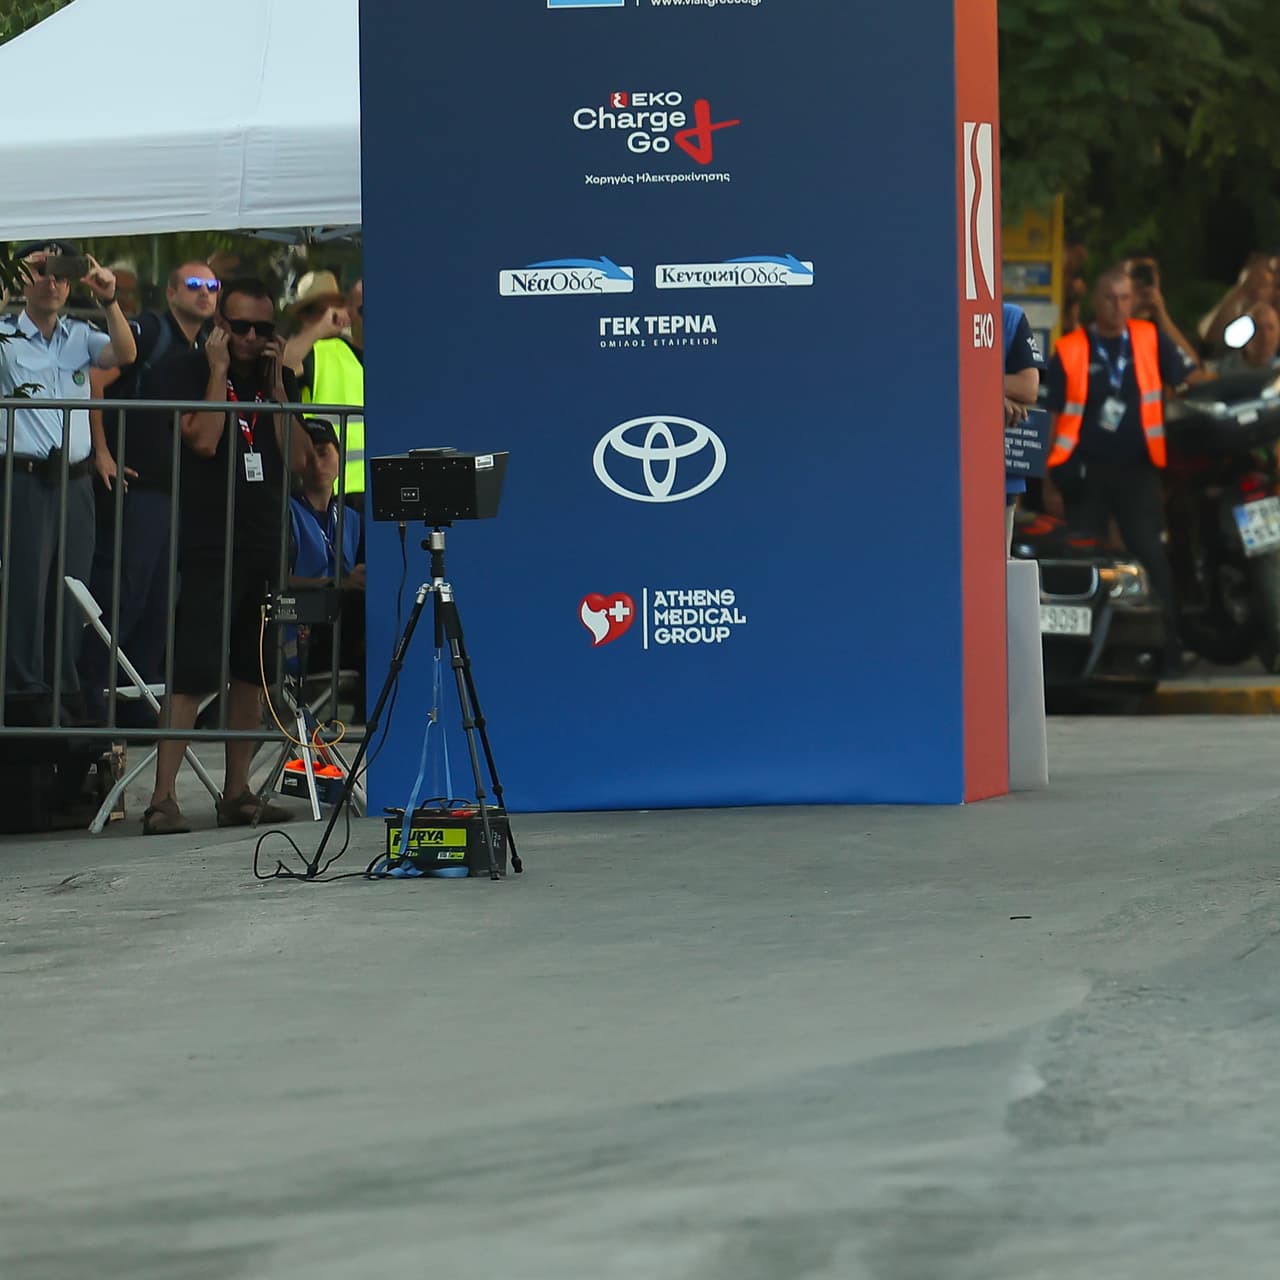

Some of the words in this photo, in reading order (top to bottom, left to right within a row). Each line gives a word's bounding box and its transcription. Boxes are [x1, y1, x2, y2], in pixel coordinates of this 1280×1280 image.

[631, 91, 683, 107] EKO
[573, 106, 686, 133] Charge
[627, 131, 671, 153] Go
[585, 173, 634, 186] Χορηγός
[599, 316, 641, 336] ΓΕΚ
[644, 314, 718, 335] ΤΕΡΝΑ
[973, 313, 994, 348] EKO
[653, 589, 736, 607] ATHENS
[654, 607, 747, 625] MEDICAL
[654, 626, 730, 644] GROUP
